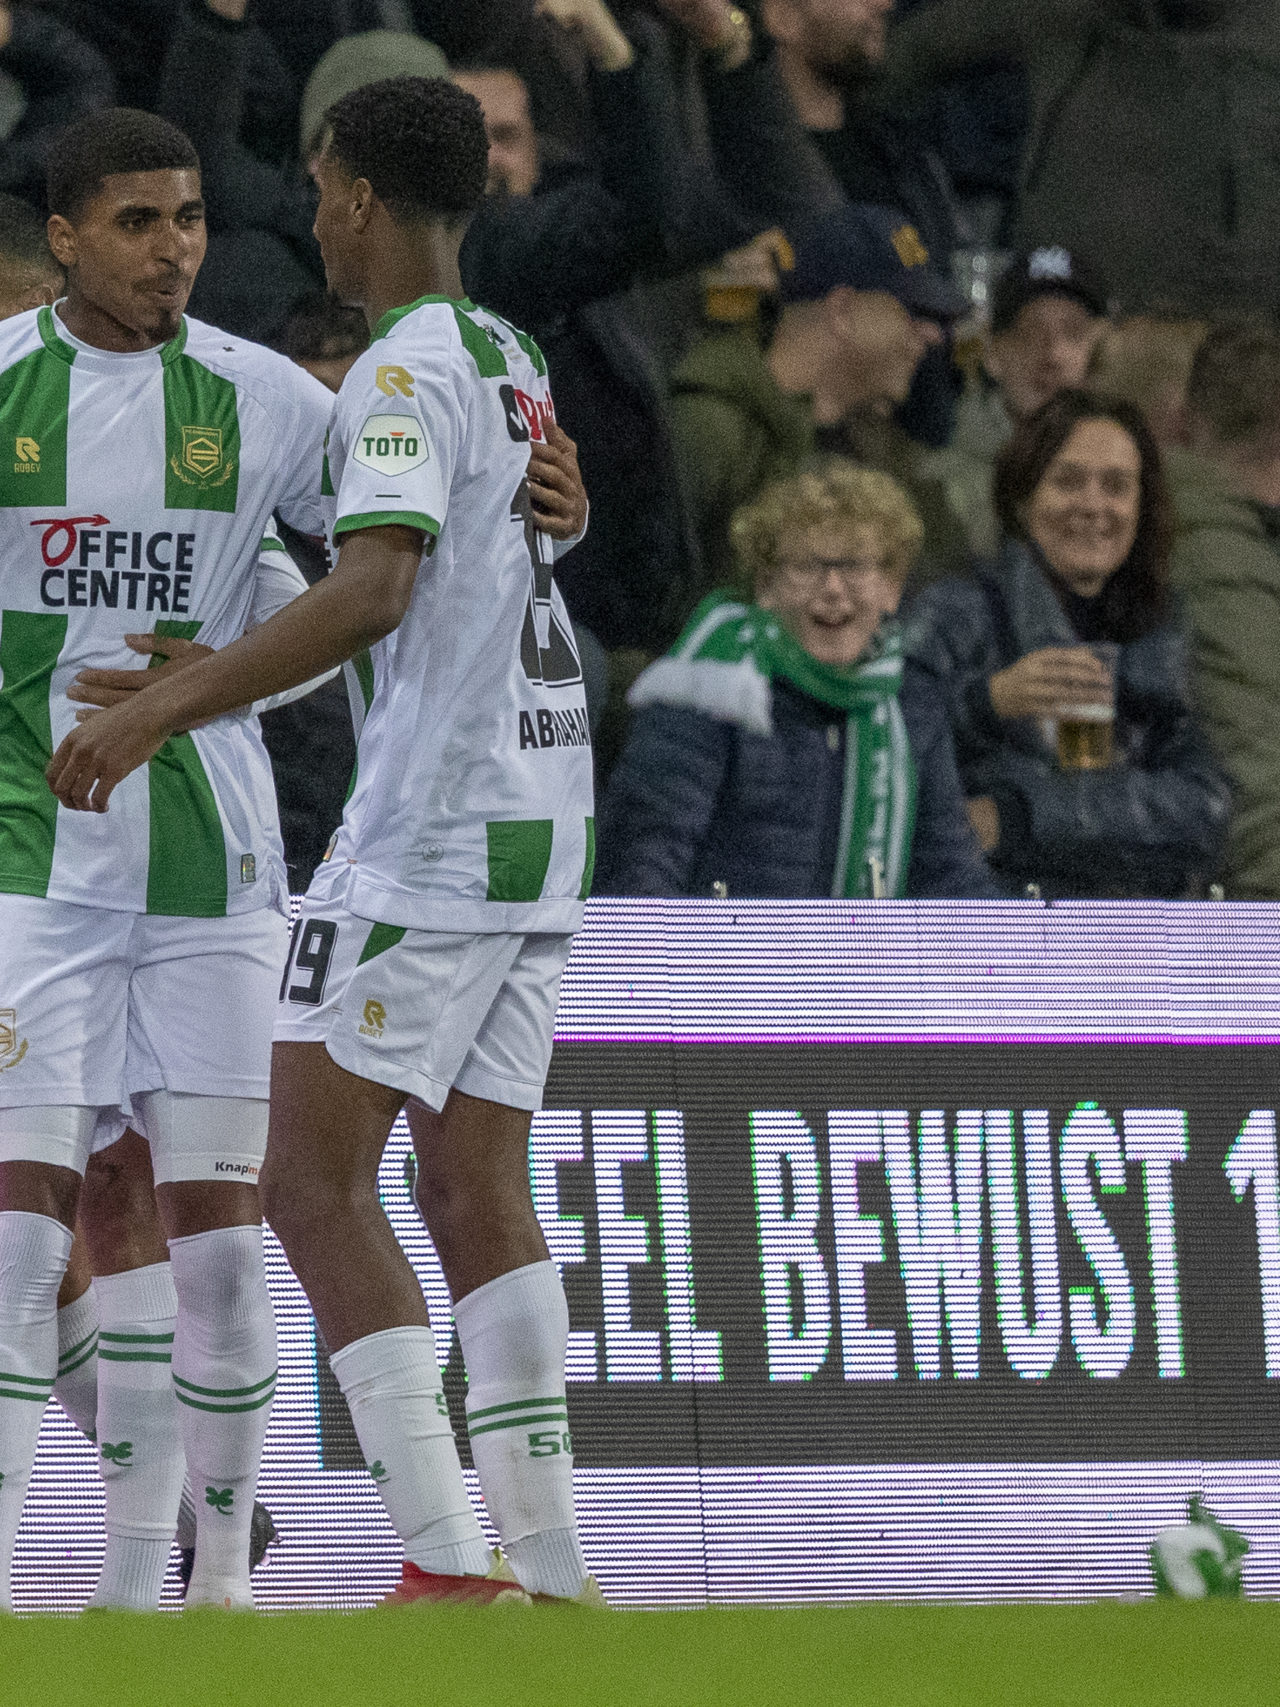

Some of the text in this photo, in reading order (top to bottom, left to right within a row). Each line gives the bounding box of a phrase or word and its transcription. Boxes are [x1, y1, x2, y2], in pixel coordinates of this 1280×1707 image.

[363, 432, 418, 457] TOTO
[40, 517, 196, 573] OFFICE
[39, 568, 192, 614] CENTRE
[518, 707, 591, 750] ABRAHA
[215, 1161, 260, 1176] Knap'm
[748, 1100, 1189, 1384] BEWUST
